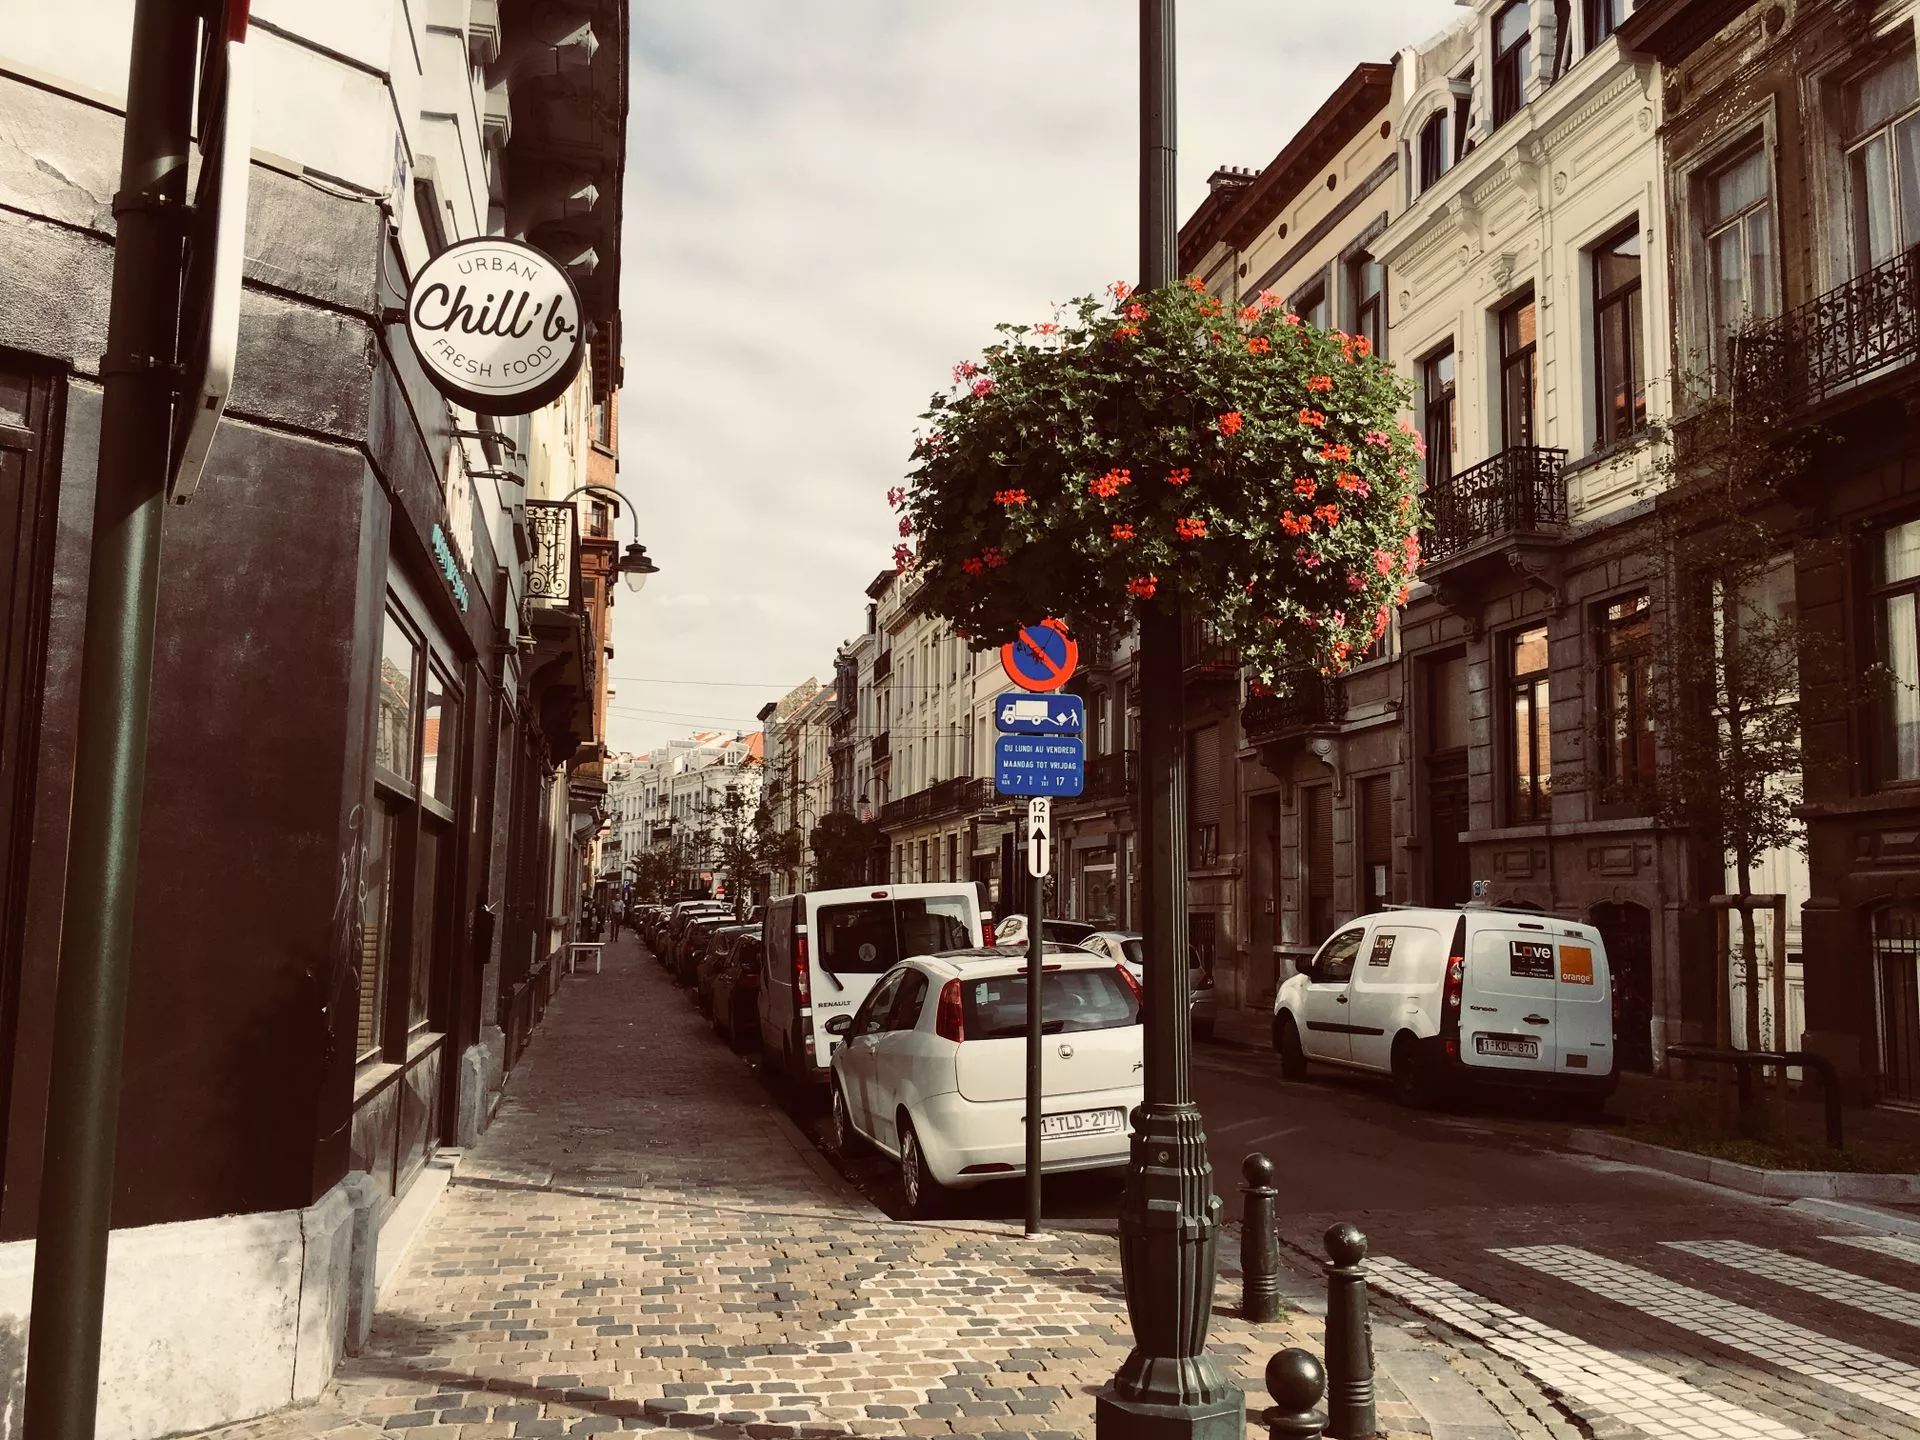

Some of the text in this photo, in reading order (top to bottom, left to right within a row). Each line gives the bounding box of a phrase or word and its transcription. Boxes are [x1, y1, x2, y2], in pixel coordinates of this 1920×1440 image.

[457, 257, 538, 282] URBAN
[432, 338, 552, 378] FRESH FOOD
[1004, 744, 1076, 754] DU LUNDI AU VENDREDI
[1003, 760, 1077, 770] MAANDAG TOT VRIJDAG
[1016, 775, 1022, 785] 7
[1056, 776, 1065, 786] 17
[1032, 802, 1046, 813] 12
[1033, 815, 1045, 824] m
[1562, 972, 1591, 983] orange
[818, 1000, 851, 1008] RENAULT
